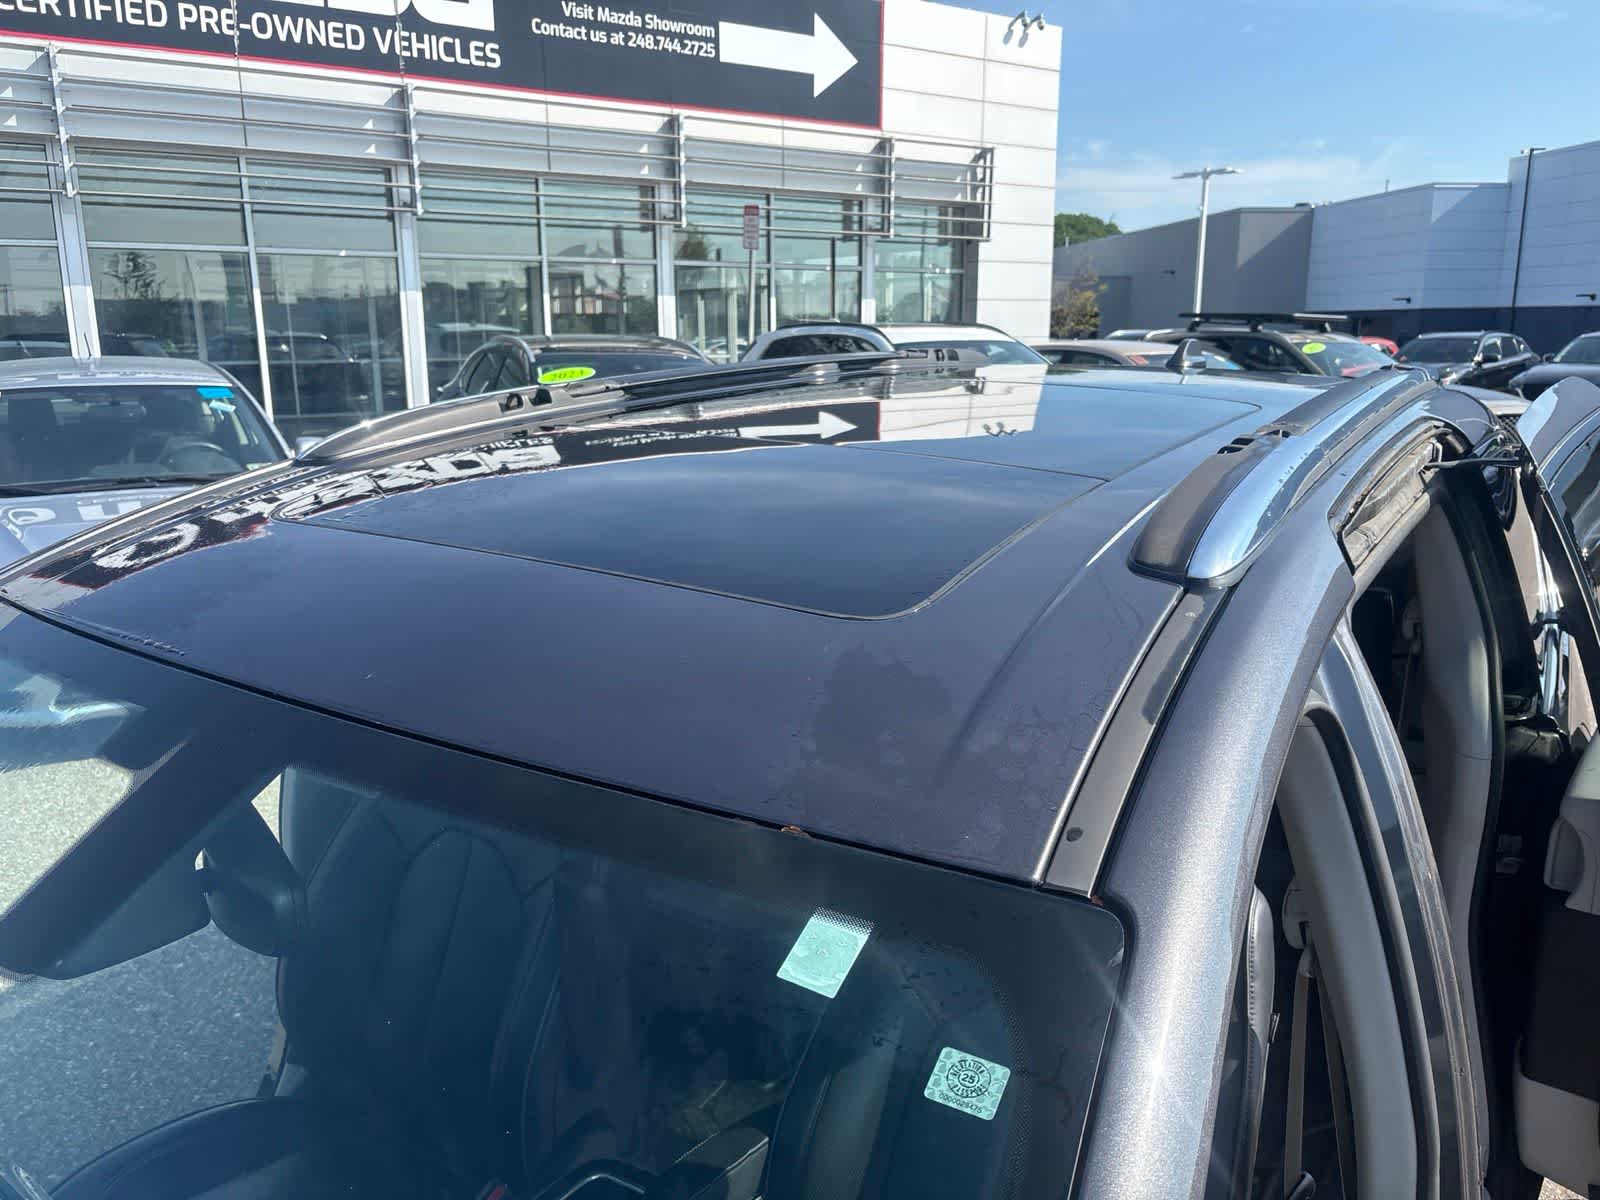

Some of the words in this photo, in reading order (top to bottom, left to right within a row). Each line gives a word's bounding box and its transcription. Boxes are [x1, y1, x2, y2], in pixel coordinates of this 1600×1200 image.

[177, 3, 365, 51] PRE-OWNED
[373, 27, 501, 68] VEHICLES
[531, 18, 587, 40] Contact
[590, 30, 607, 43] us
[610, 32, 625, 46] at
[627, 31, 715, 57] 248.744.2725
[561, 1, 594, 20] Visit
[597, 6, 642, 28] Mazda
[645, 14, 715, 38] Showroom
[960, 1073, 977, 1085] 25
